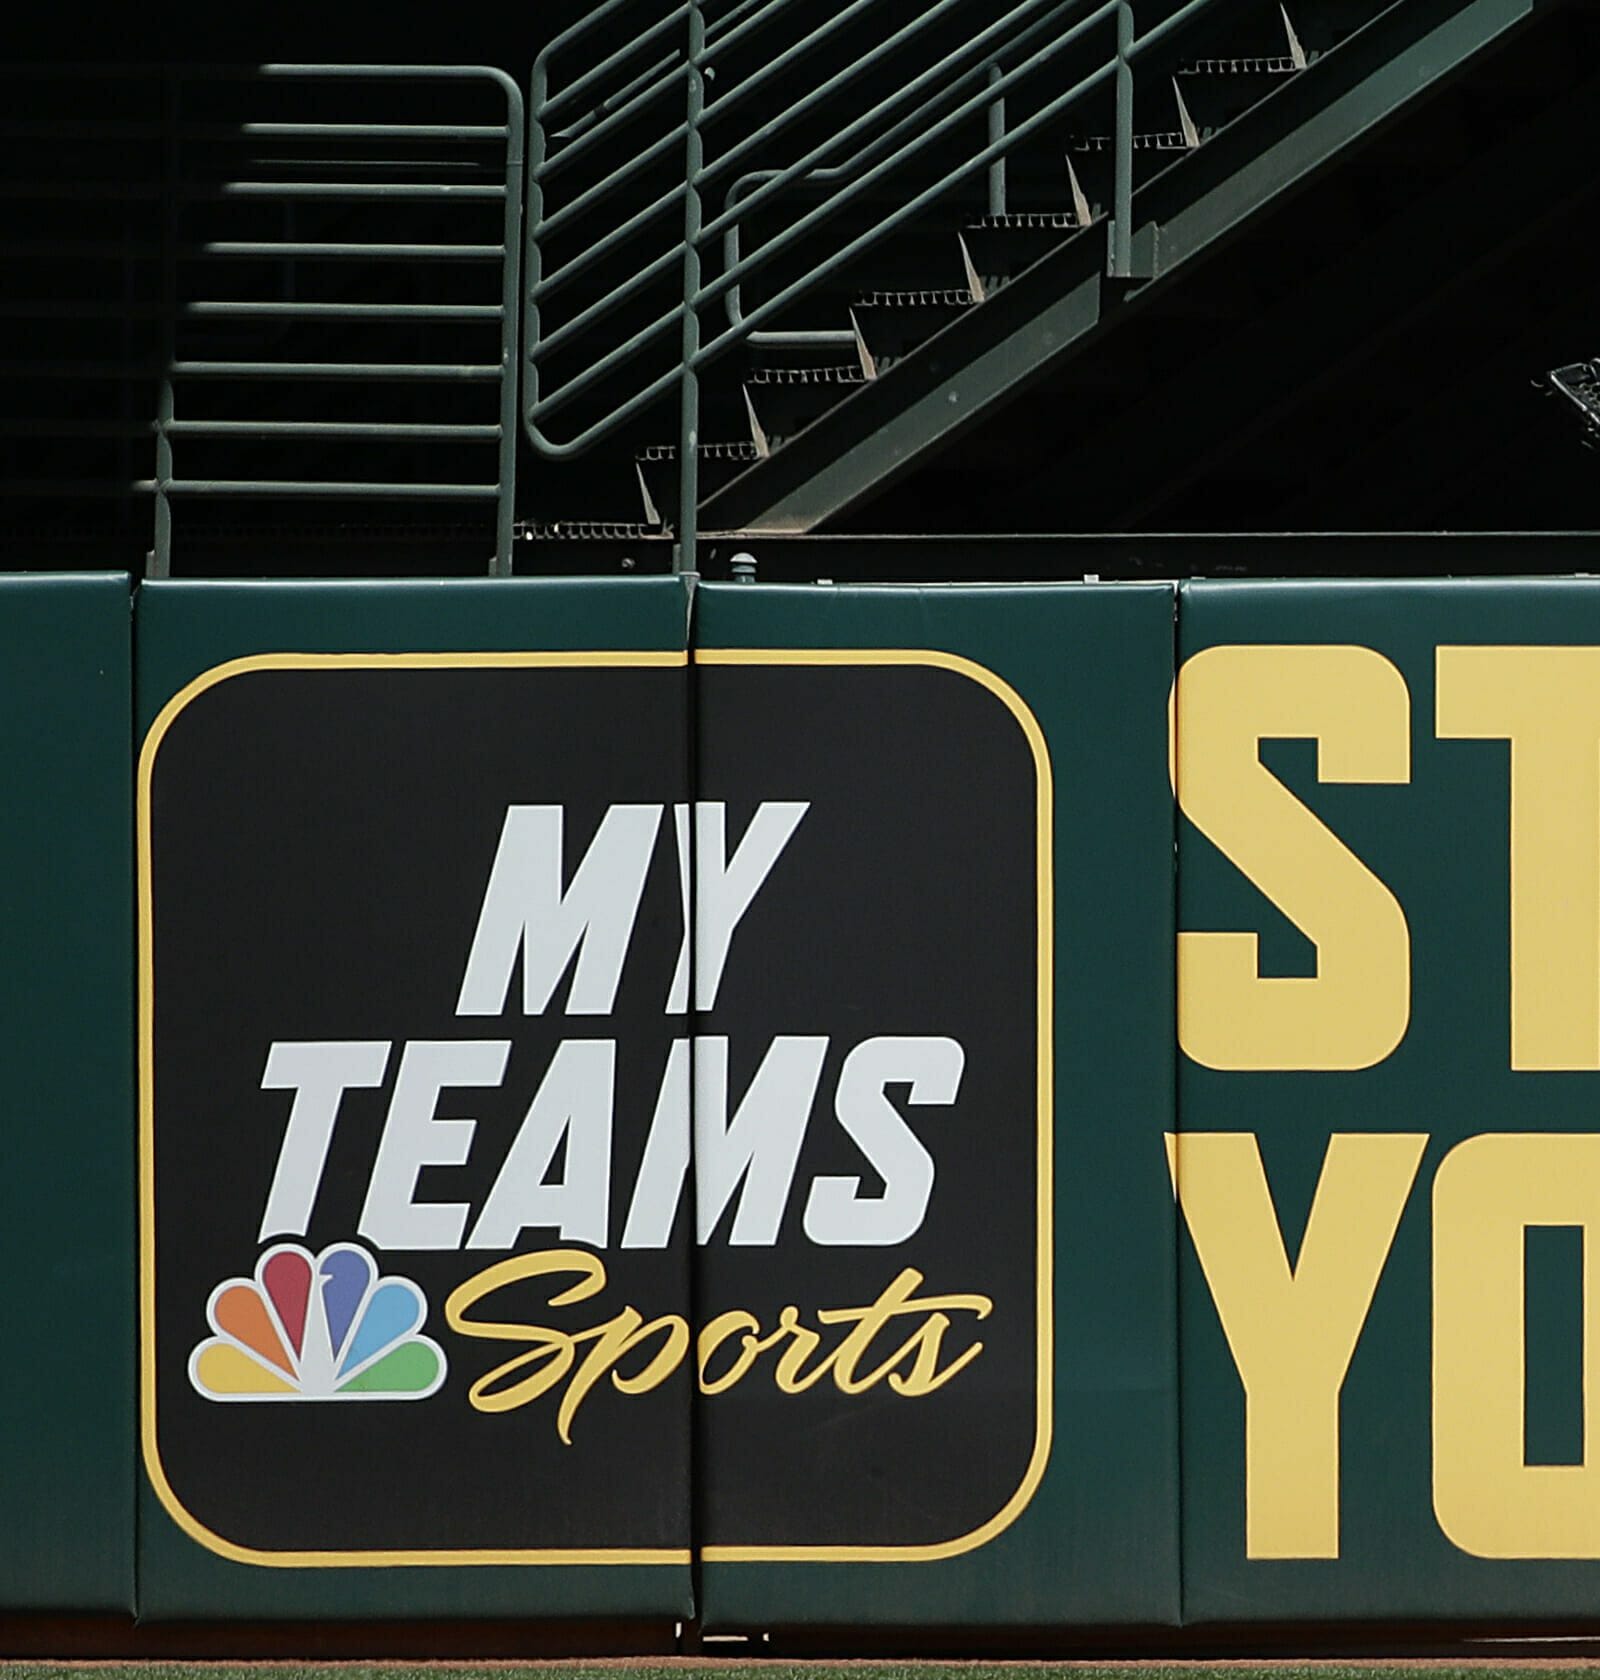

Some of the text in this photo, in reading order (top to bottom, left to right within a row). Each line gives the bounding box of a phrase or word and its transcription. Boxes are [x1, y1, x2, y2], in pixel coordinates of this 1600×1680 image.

[455, 801, 811, 1016] MY
[257, 1035, 966, 1250] TEAMS
[443, 1248, 994, 1446] Sports
